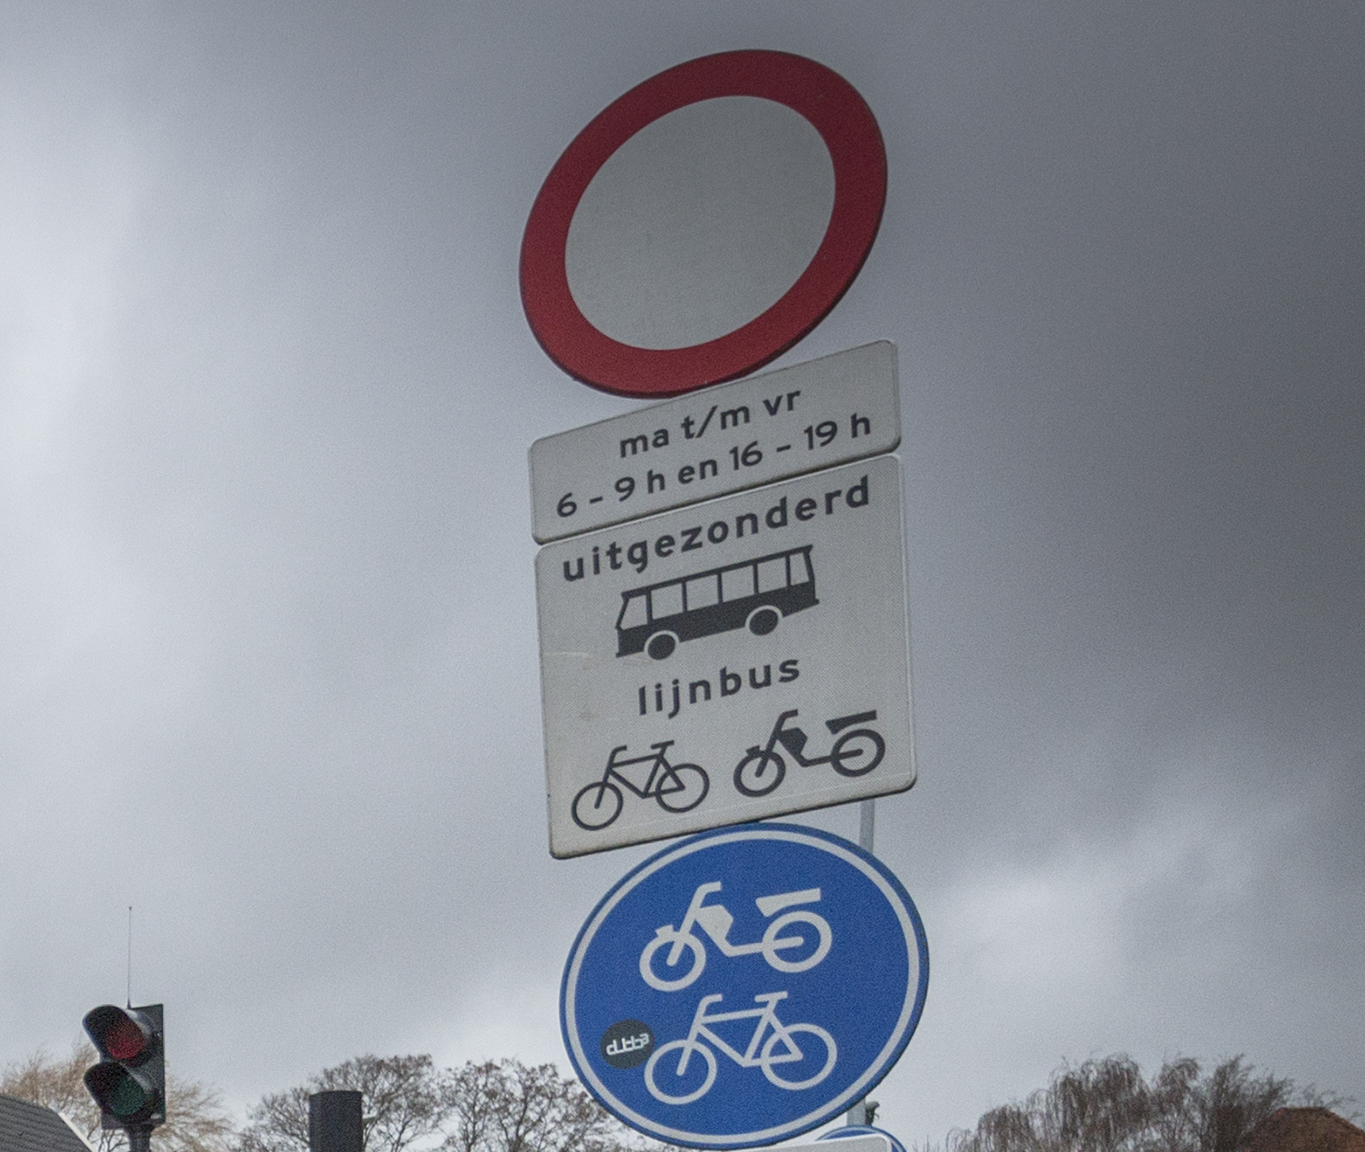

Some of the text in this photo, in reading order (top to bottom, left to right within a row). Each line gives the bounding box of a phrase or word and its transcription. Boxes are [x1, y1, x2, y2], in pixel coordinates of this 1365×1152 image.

[556, 492, 578, 518] 6
[614, 476, 636, 502] 9
[646, 469, 666, 494] h
[677, 458, 719, 485] en
[729, 440, 764, 471] 16
[803, 420, 839, 451] 19
[850, 412, 872, 439] h
[619, 389, 802, 459] ma t/m vr
[562, 474, 871, 582] uitgezonderd
[638, 658, 801, 720] lijnbus
